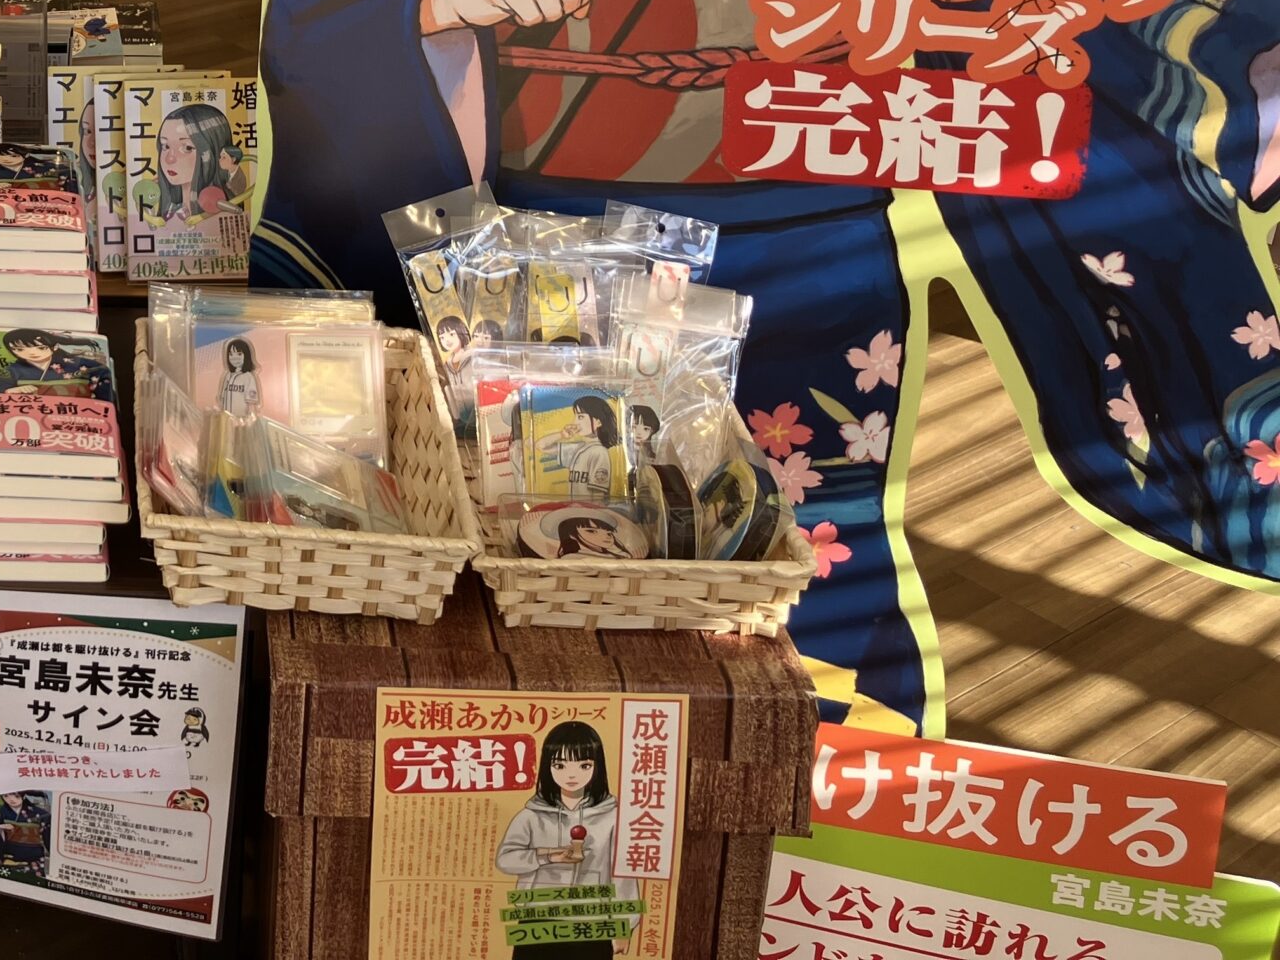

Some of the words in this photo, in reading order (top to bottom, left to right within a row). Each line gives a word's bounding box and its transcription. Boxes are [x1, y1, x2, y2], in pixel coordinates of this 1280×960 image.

[169, 92, 218, 103] 宮島未奈
[231, 80, 258, 149] 婚活
[741, 69, 1067, 189] 完結!
[129, 86, 157, 254] マエストロ
[8, 639, 141, 659] 『成瀬は都を駆け抜ける』
[144, 650, 192, 662] 刊行記念
[27, 699, 162, 738] サイン会
[381, 699, 608, 734] 成瀬あかりシリーズ
[15, 753, 101, 766] ご好評につき、
[17, 766, 162, 780] 受付は終了いたしました
[391, 738, 530, 791] 完結!
[625, 707, 670, 874] 成瀬班会報
[811, 744, 1189, 869] け抜ける
[509, 885, 613, 905] シリーズ最終巻
[648, 882, 664, 926] 2025.12
[1049, 872, 1229, 931] 宮島未奈
[508, 921, 628, 943] ついに発売!
[642, 928, 662, 958] 冬号
